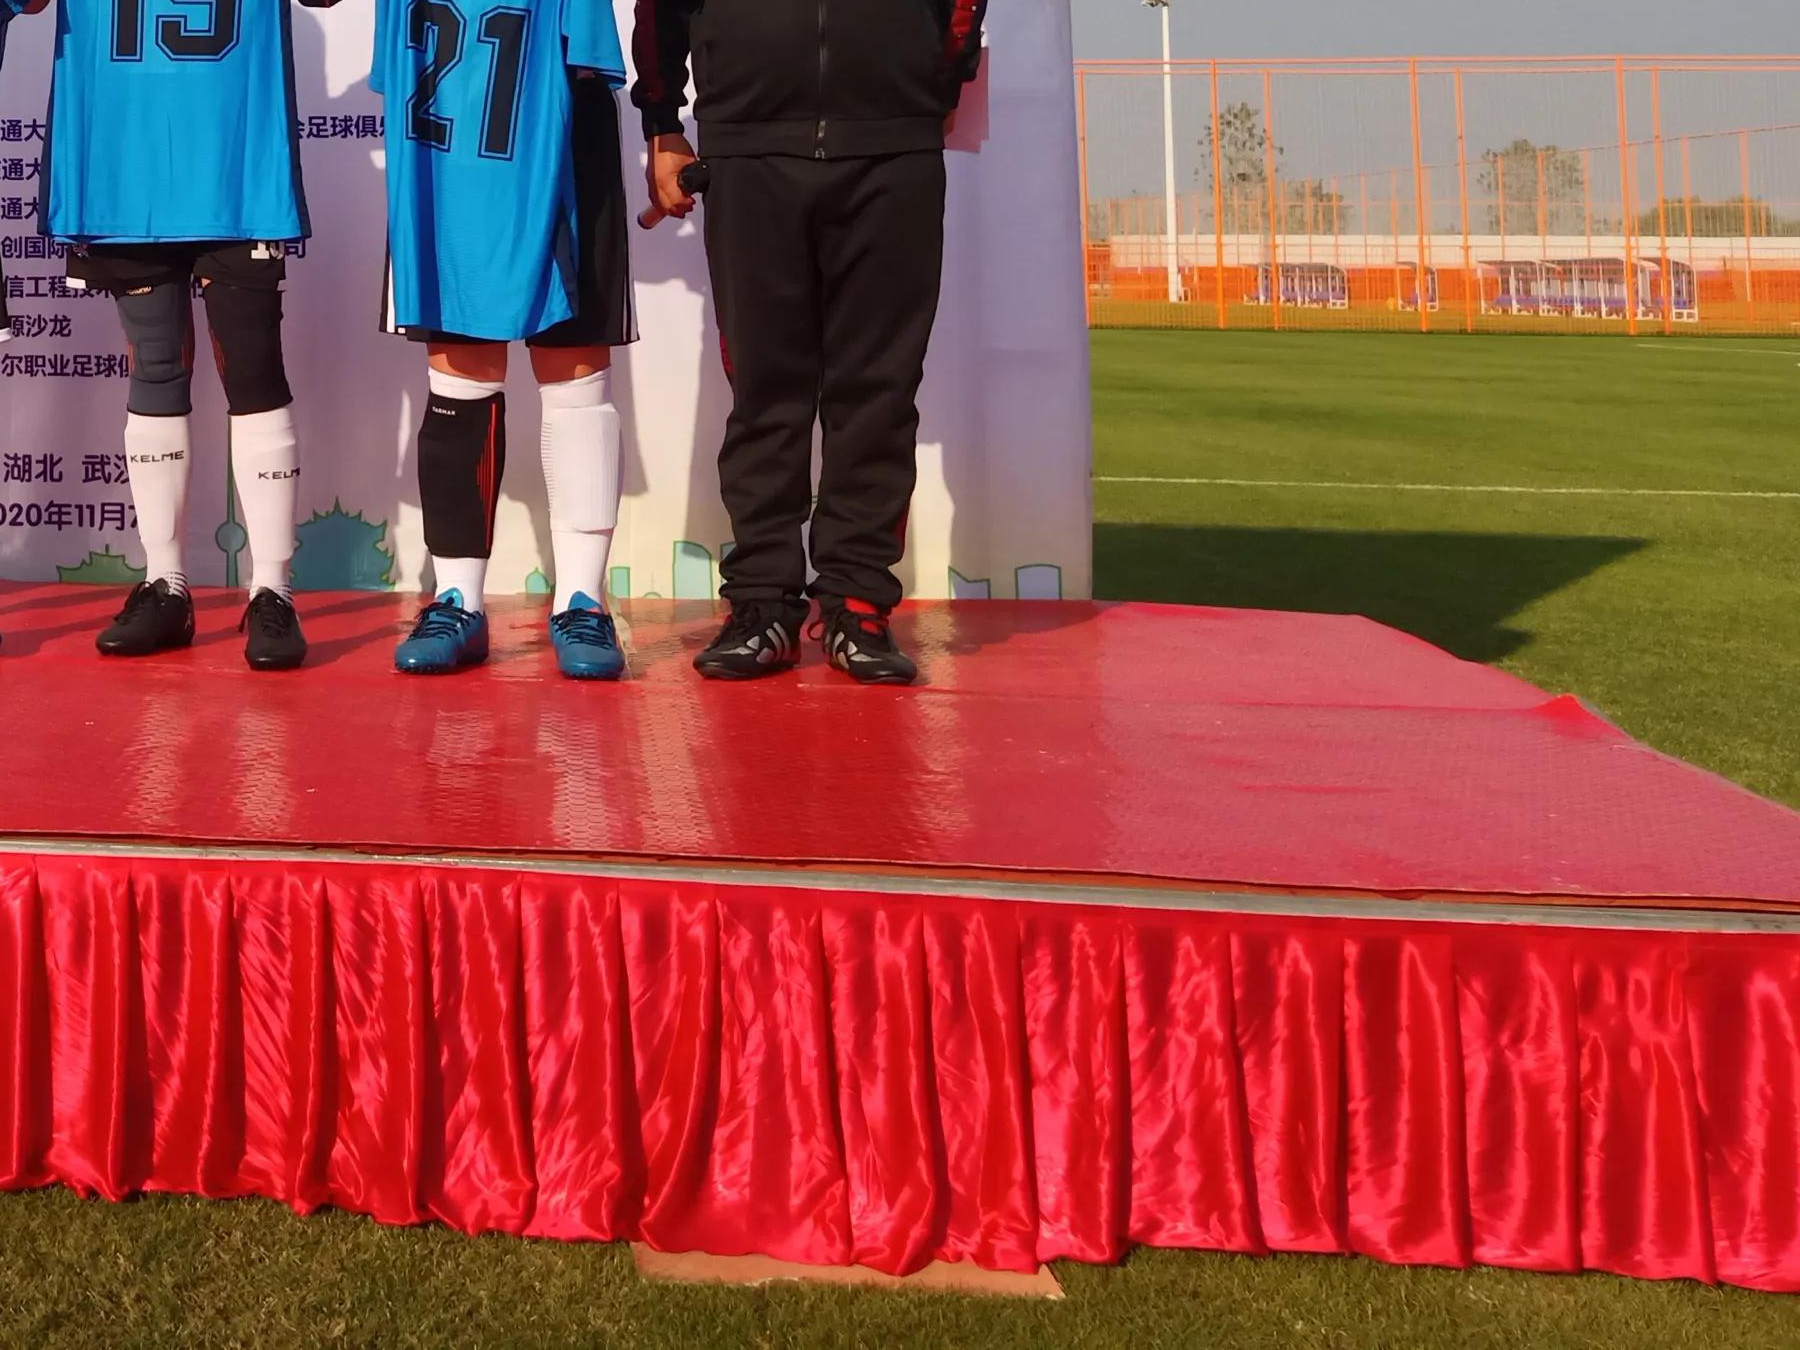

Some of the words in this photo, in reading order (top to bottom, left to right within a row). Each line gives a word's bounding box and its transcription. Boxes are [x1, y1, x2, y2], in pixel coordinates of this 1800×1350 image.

[298, 115, 385, 139] 足球俱
[130, 450, 185, 463] KELME
[3, 452, 63, 483] 湖北
[258, 467, 300, 480] KELM
